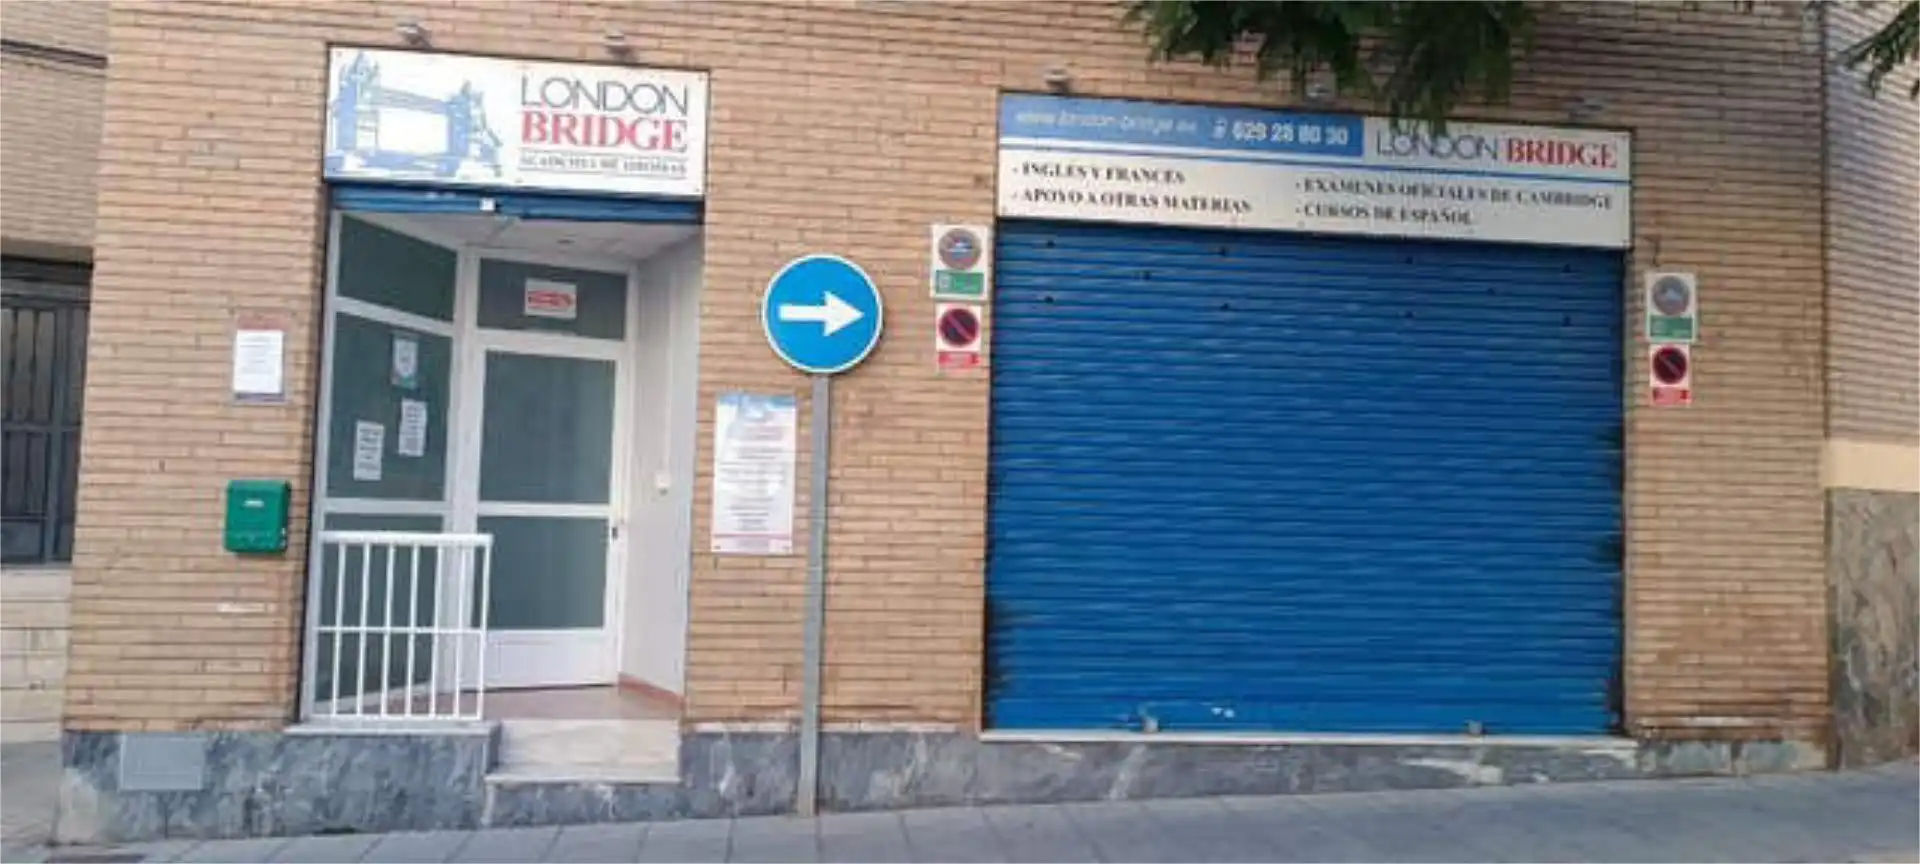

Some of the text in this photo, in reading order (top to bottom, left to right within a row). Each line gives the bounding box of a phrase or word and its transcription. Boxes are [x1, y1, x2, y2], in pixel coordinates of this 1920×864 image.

[521, 76, 688, 117] LONDON
[520, 112, 689, 153] BRIDGE
[1376, 128, 1618, 169] LONDON BRIDGE
[1023, 187, 1253, 214] APOYO A OTRAS MATERIAS
[1303, 202, 1370, 219] CURSOS
[1372, 204, 1394, 220] DE
[1490, 187, 1512, 204] DE
[1515, 190, 1613, 211] CAMBRIDGE
